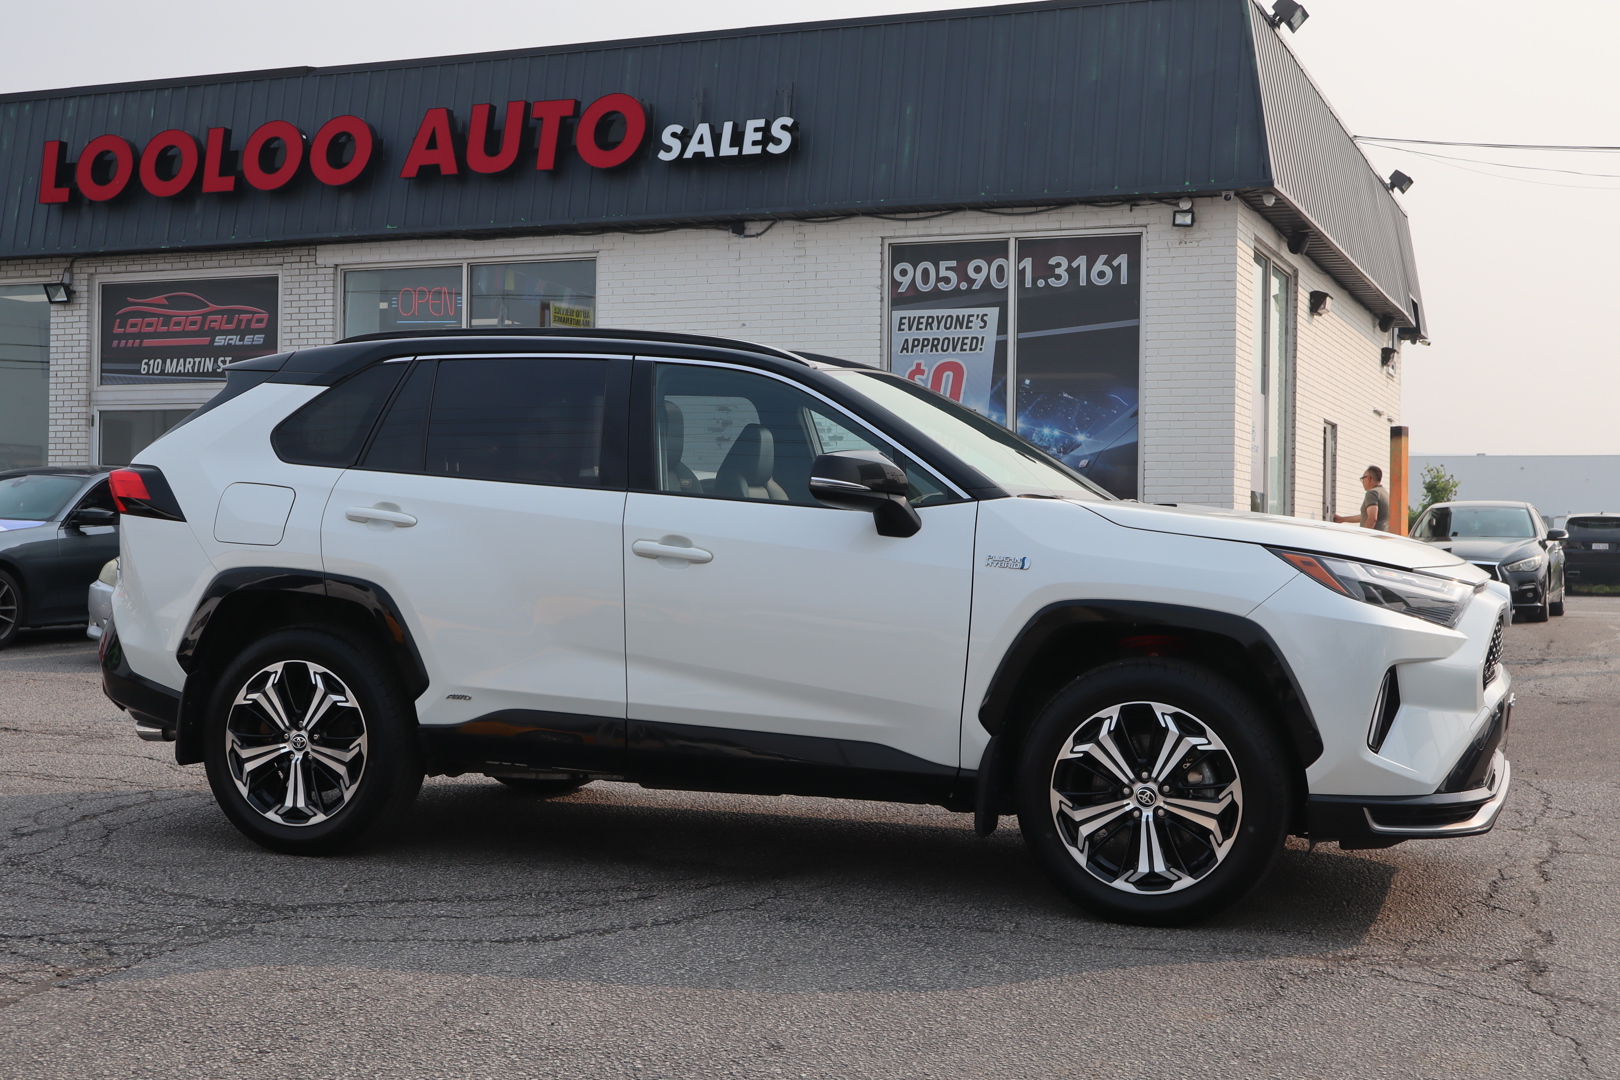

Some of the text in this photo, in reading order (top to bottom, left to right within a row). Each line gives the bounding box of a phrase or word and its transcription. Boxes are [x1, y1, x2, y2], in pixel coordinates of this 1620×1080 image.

[38, 93, 796, 204] LOOLOO AUTO SALES
[893, 253, 1129, 293] 905.901.3161
[397, 286, 456, 316] OPEN
[113, 313, 270, 334] LOOLOO AUTO
[897, 313, 989, 333] EVERYONE'S
[213, 334, 265, 346] SALES
[899, 336, 986, 355] APPROVED!
[140, 358, 163, 375] 610
[164, 356, 215, 374] MARTIN
[985, 561, 1020, 570] HYBRID
